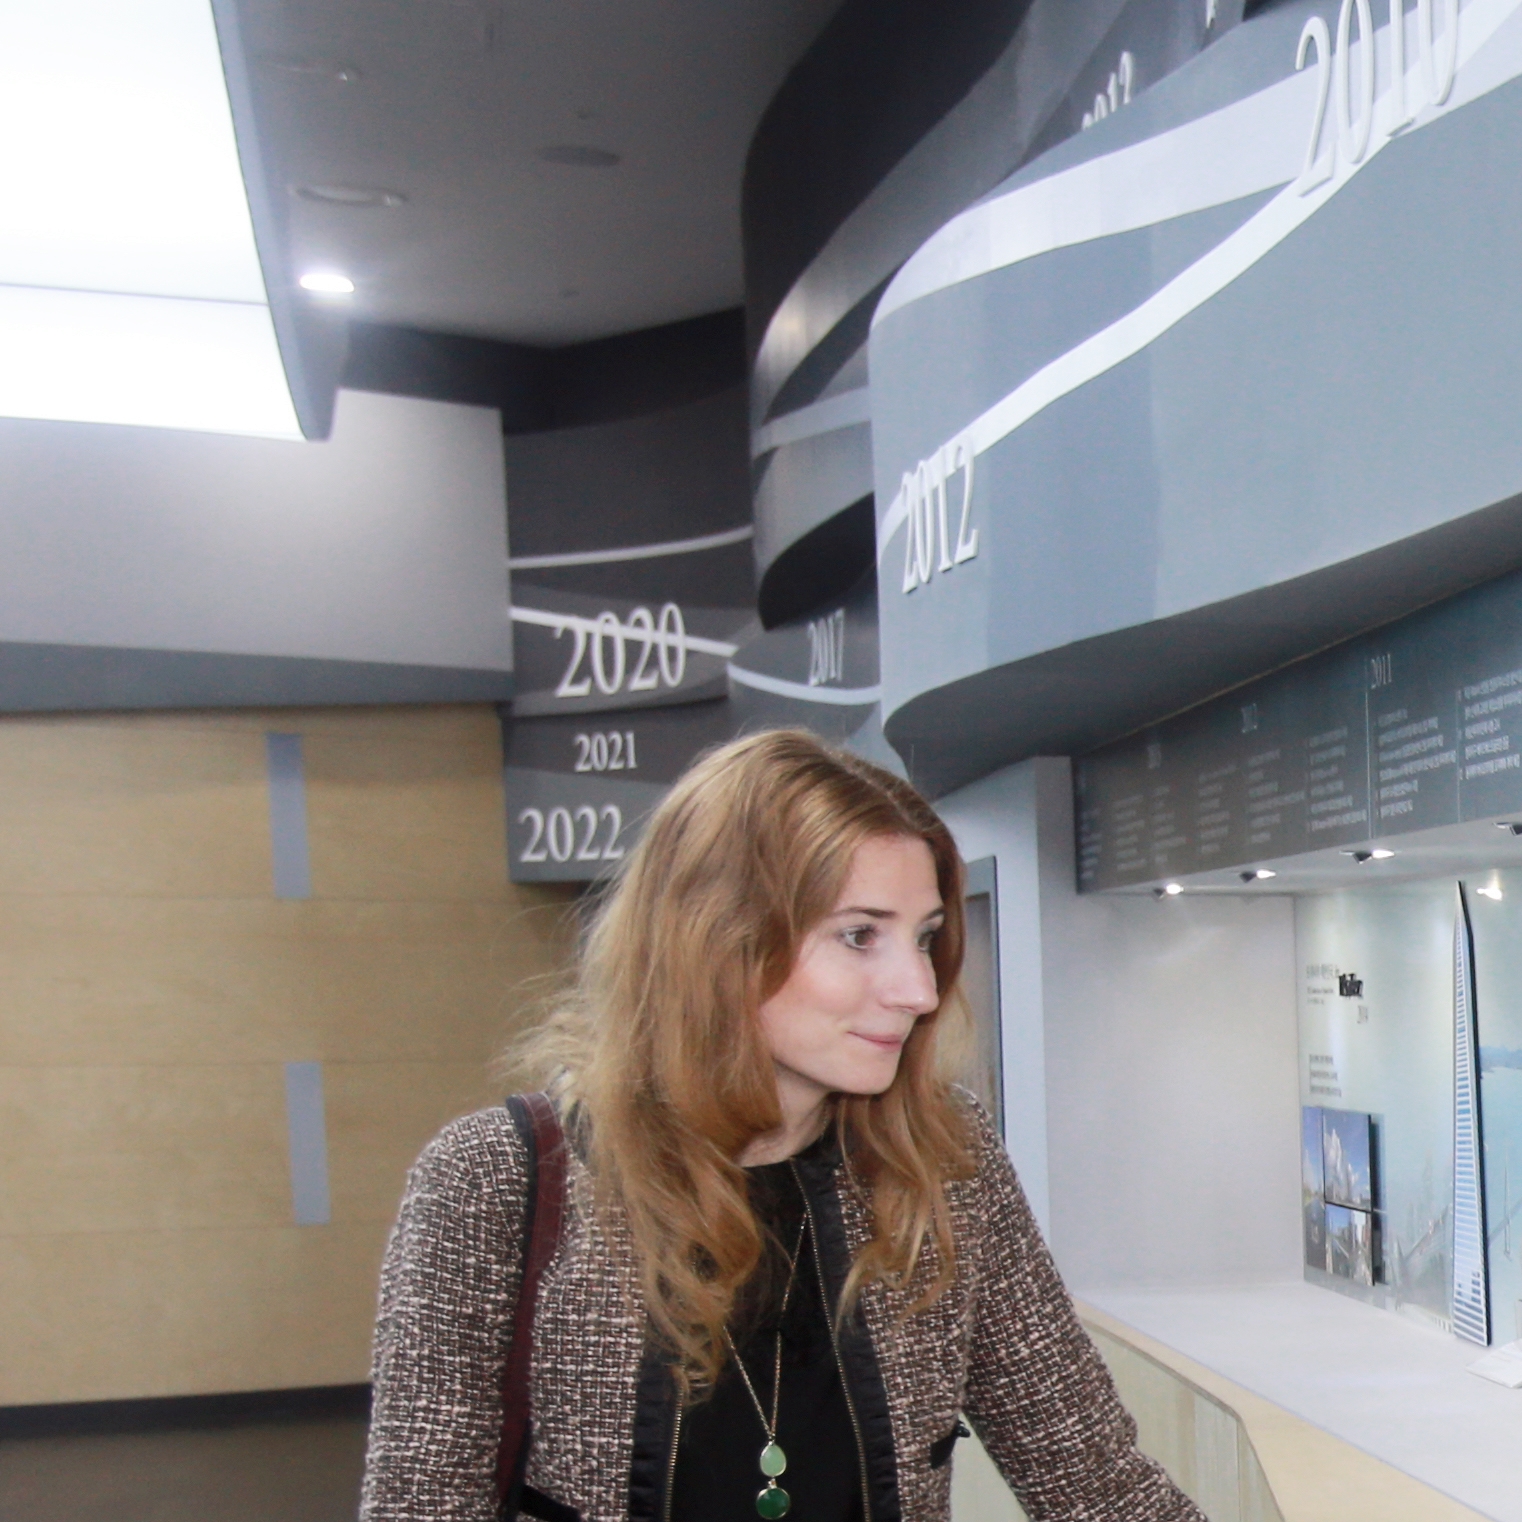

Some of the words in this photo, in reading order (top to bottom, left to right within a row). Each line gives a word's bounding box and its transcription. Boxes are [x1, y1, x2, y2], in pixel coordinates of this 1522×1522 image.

[901, 440, 980, 594] 2012
[554, 602, 687, 699] 2020
[808, 608, 847, 687] 2017
[574, 731, 638, 774] 2021
[518, 804, 625, 863] 2022
